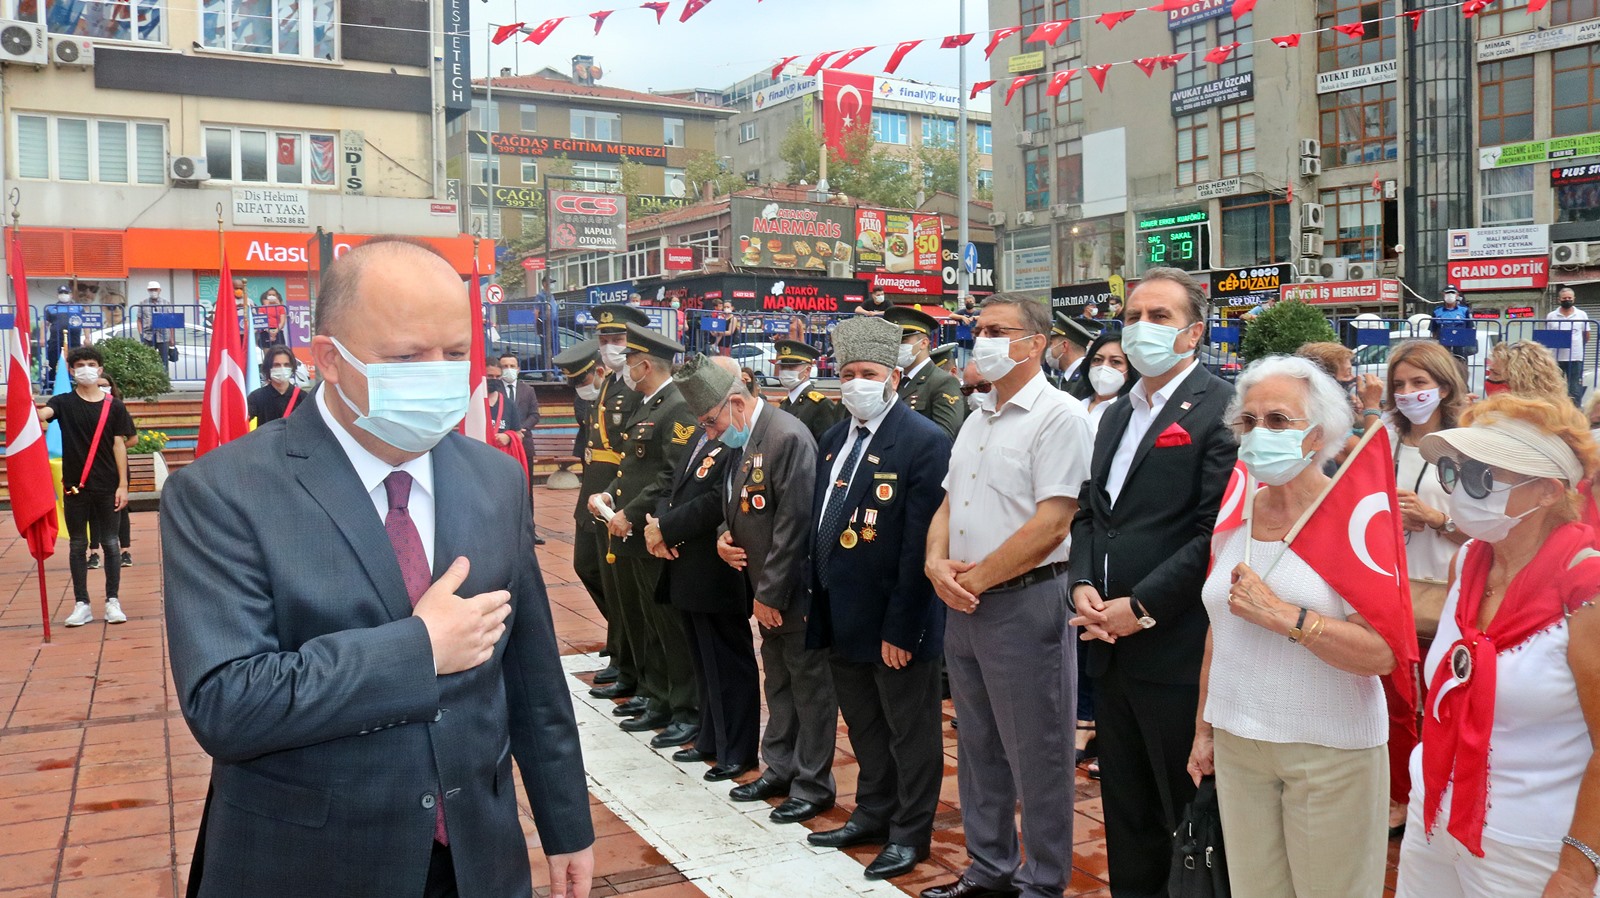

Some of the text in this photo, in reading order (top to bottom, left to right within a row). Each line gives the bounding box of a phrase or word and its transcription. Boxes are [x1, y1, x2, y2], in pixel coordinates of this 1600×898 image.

[1320, 70, 1350, 84] AVUKAT
[1352, 66, 1371, 78] RIZA
[797, 79, 816, 91] kurs
[1172, 74, 1251, 102] AVUKAT ALEV ÖZCAN
[490, 134, 666, 158] ÇAĞDAŞ EĞİTİM MERKEZİ
[1562, 166, 1584, 178] PLUS
[264, 191, 298, 202] Hekimi
[237, 202, 272, 214] RIFAT
[556, 196, 618, 216] CCS
[778, 208, 818, 220] ATAKÖY
[584, 227, 612, 236] KAPALI
[753, 217, 841, 238] MARMARİS
[860, 218, 882, 232] TAKO
[579, 237, 617, 245] OTOPARK
[1148, 232, 1192, 244] SAÇ SAKAL
[1152, 240, 1192, 262] 12 9
[668, 254, 692, 264] komagene
[1452, 260, 1544, 278] GRAND OPTİK
[874, 274, 920, 290] komagene
[784, 285, 818, 295] ATAKÖY
[1320, 286, 1330, 300] İŞ
[1332, 282, 1376, 298] MERKEZİ
[764, 294, 838, 312] MARMARİS
[1229, 298, 1242, 306] CEP
